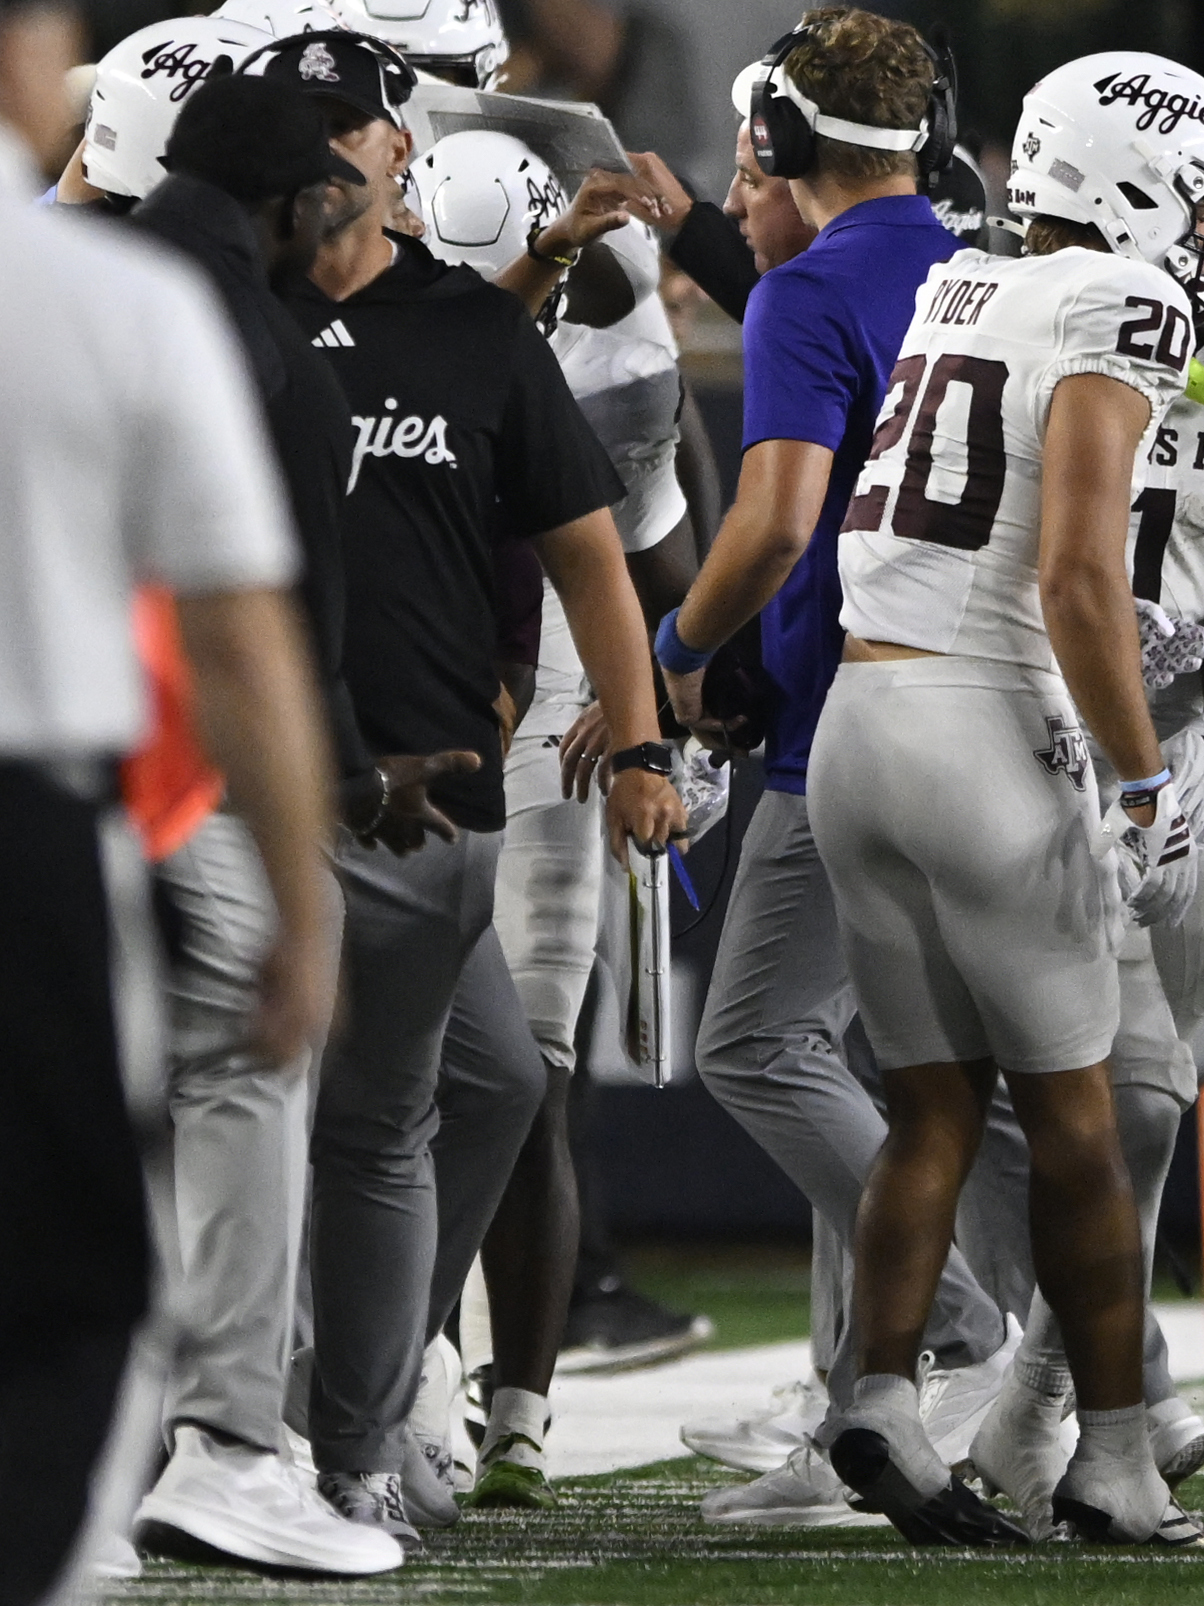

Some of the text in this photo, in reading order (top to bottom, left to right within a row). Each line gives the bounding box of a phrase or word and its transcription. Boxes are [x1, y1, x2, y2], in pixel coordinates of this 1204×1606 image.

[923, 279, 999, 326] RYDER
[1115, 295, 1191, 373] 20
[839, 353, 1010, 551] 20
